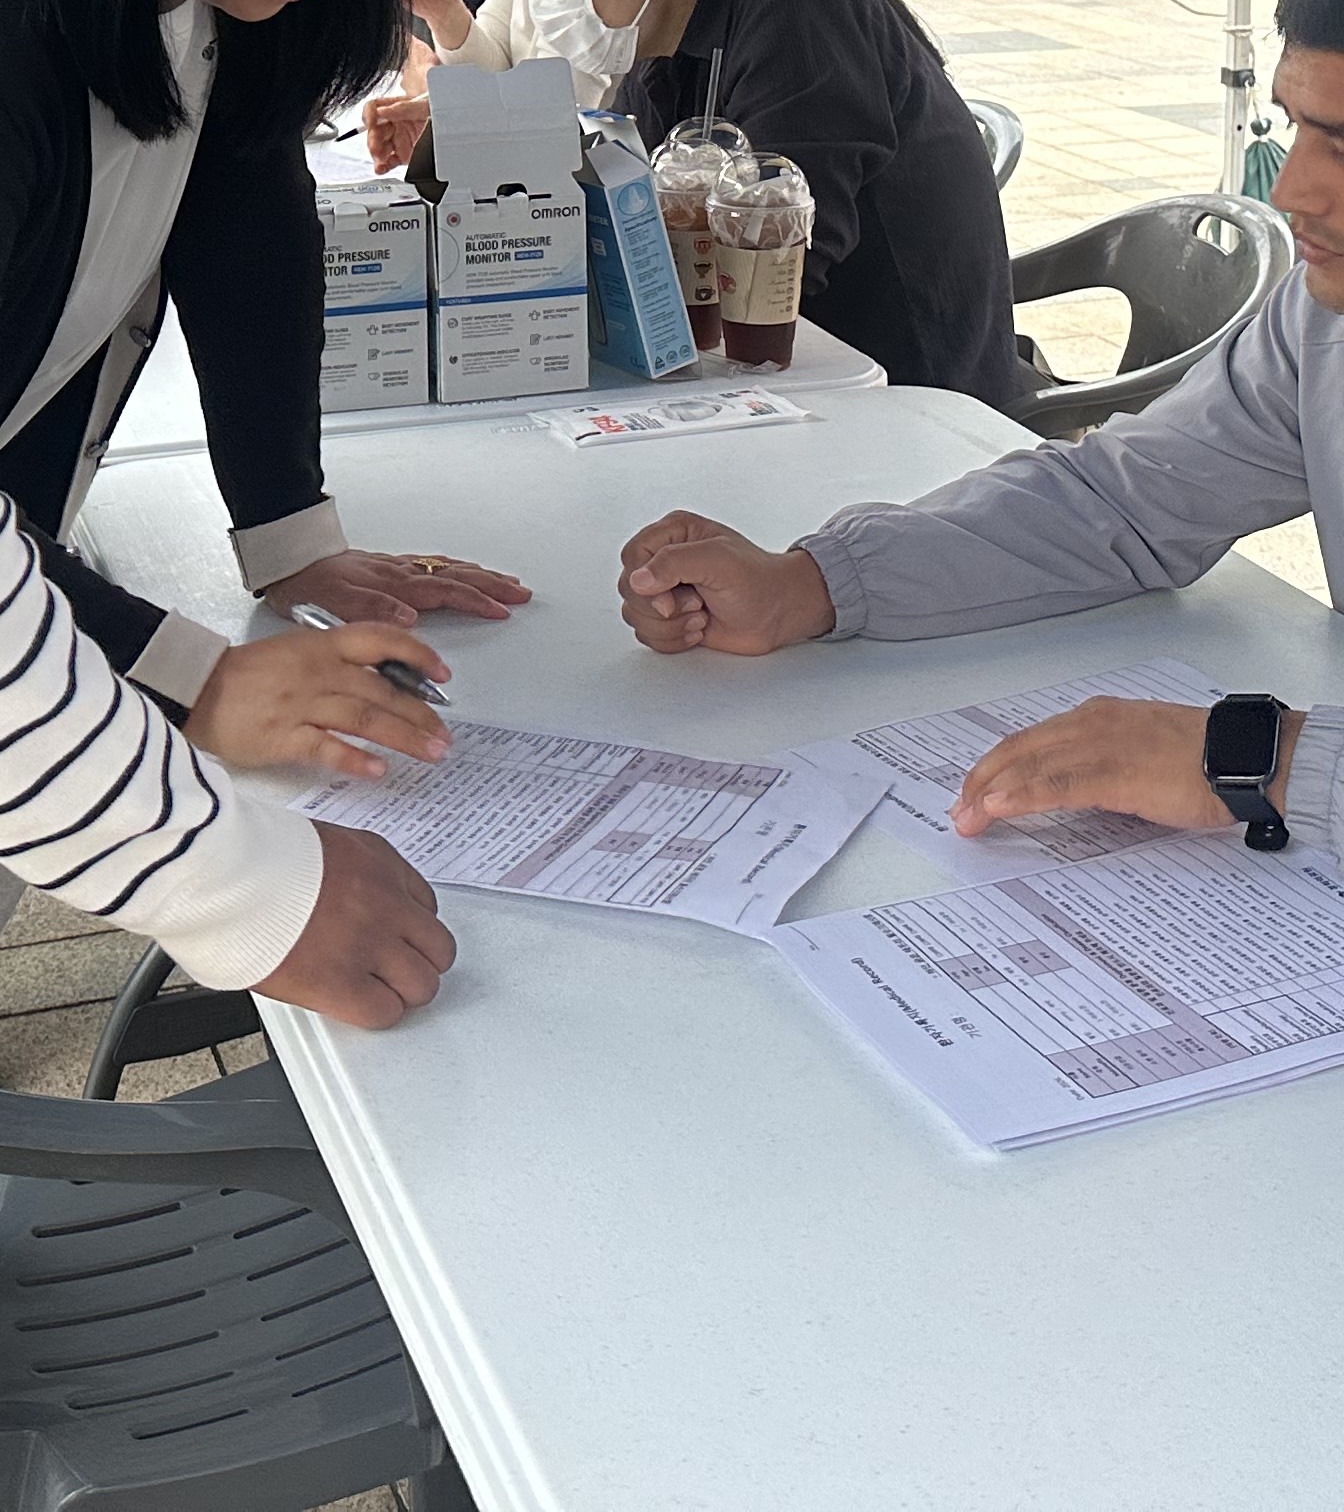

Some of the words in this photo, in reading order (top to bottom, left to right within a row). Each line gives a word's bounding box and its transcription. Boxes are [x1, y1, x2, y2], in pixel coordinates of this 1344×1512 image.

[530, 206, 581, 220] OMRON
[368, 218, 420, 233] OMRON
[466, 232, 506, 241] AUTOMATIC
[465, 239, 499, 253] BLOOD
[501, 235, 552, 250] PRESSURE
[338, 249, 390, 263] PRESSURE
[465, 252, 511, 265] MONITOR
